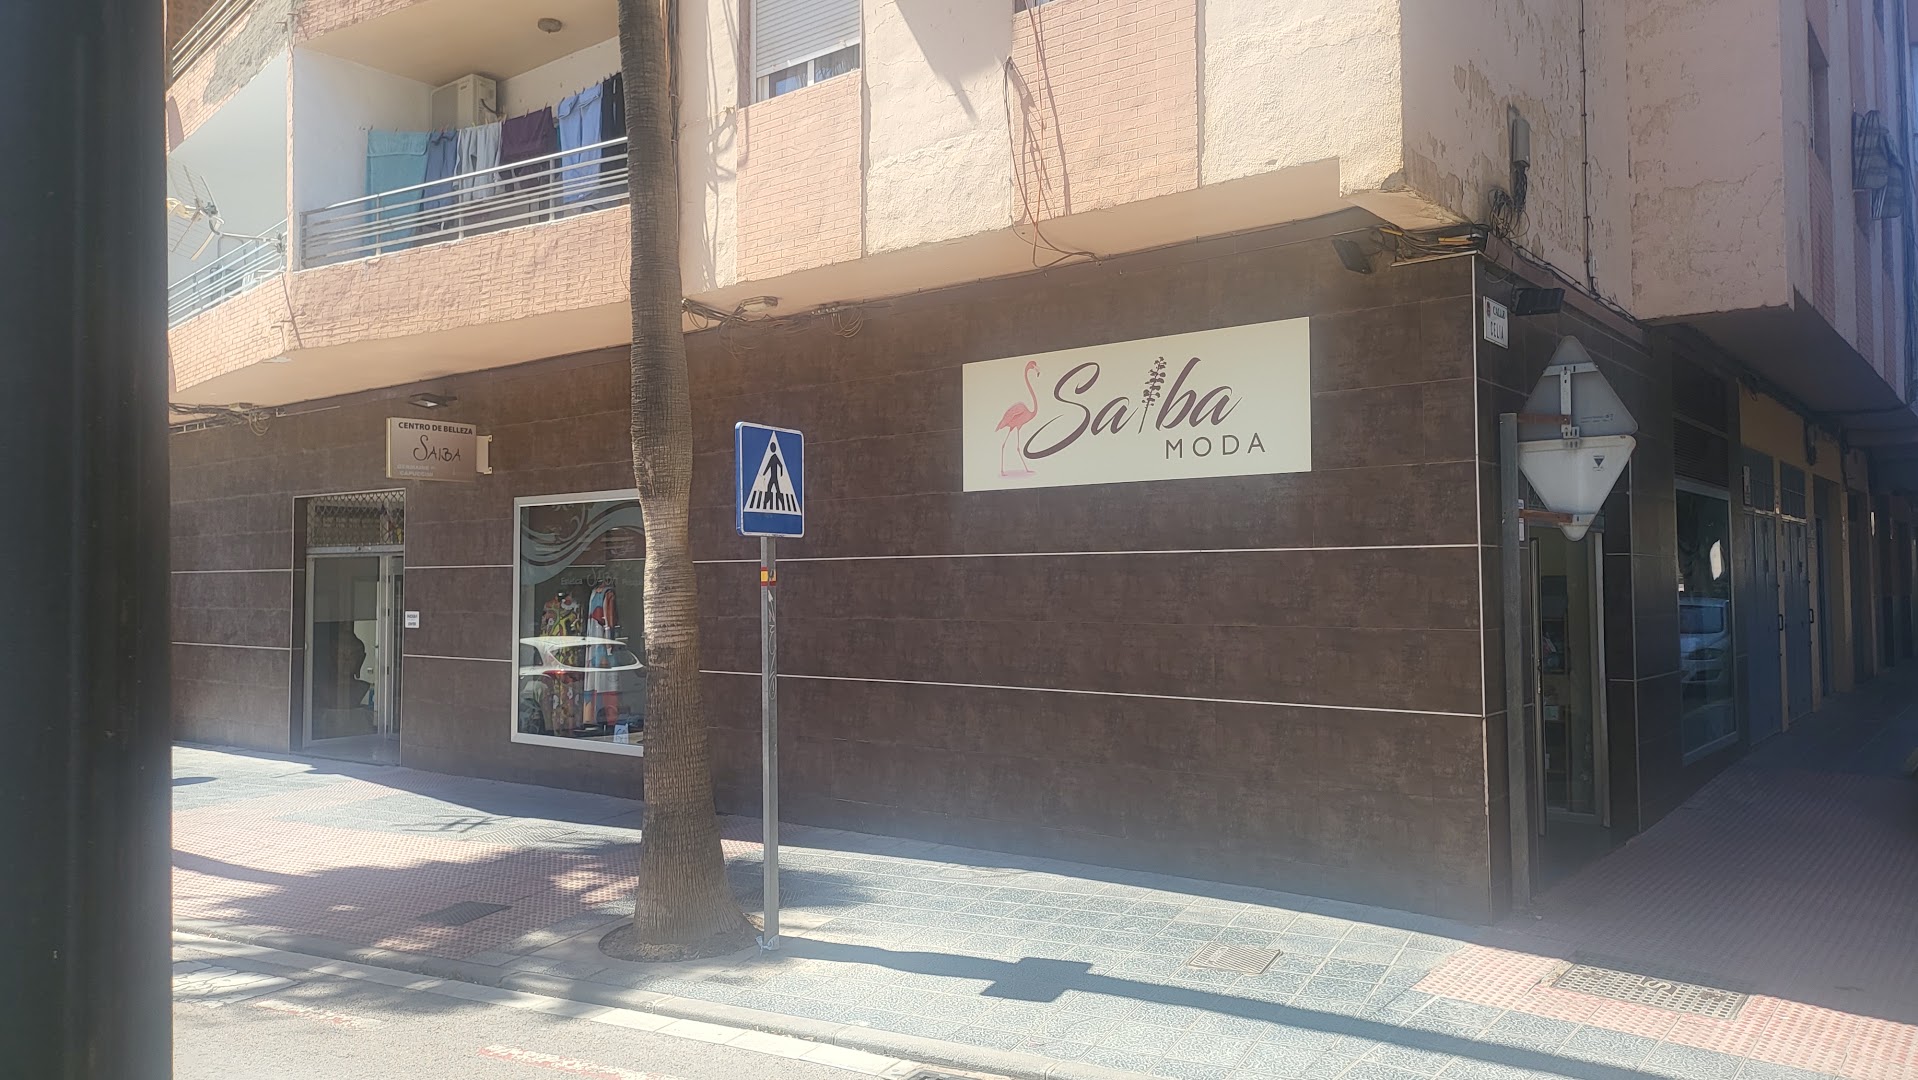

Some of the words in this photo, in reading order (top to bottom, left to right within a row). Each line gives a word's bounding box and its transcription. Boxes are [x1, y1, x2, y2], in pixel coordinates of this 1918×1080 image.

[398, 421, 431, 431] CENTRO
[432, 424, 442, 432] DE
[443, 425, 473, 435] BELLEZA
[1165, 432, 1266, 460] MODA
